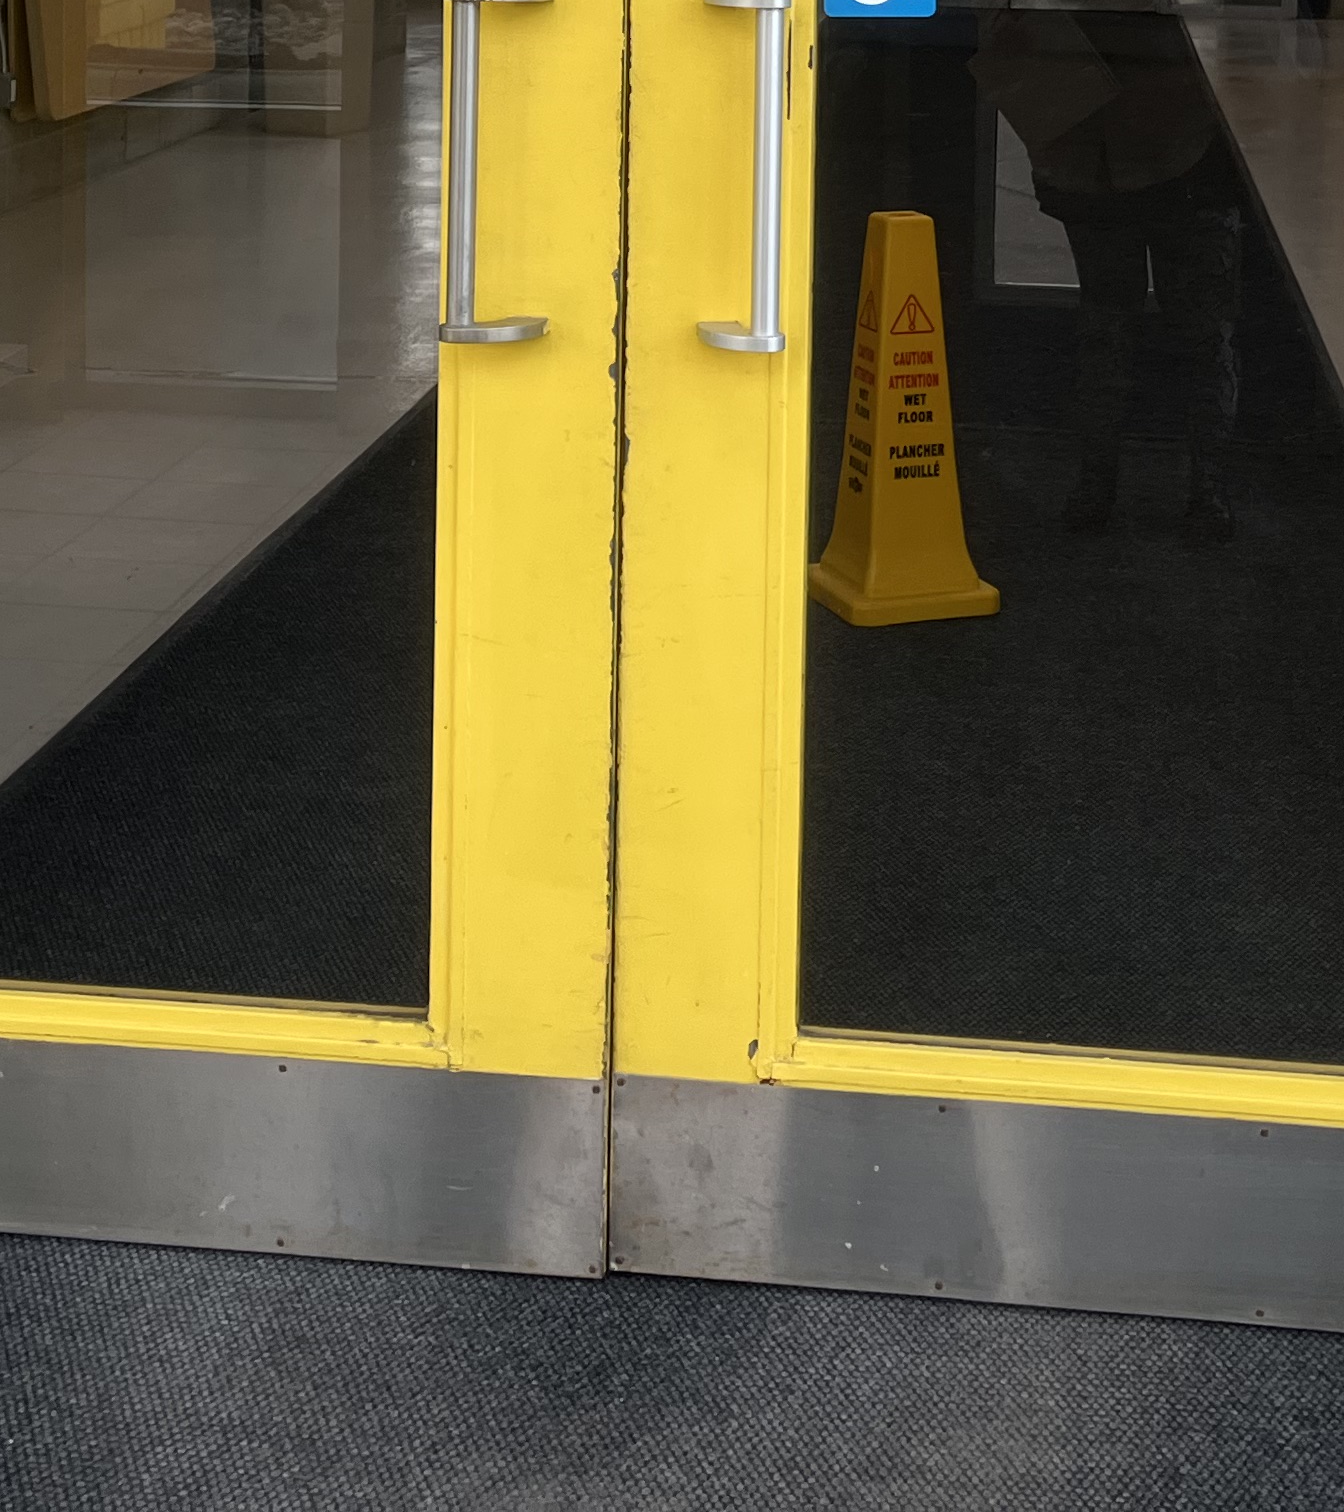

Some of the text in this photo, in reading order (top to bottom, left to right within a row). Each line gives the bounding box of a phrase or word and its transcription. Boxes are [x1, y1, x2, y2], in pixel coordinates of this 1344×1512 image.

[893, 351, 933, 366] CAUTION
[889, 374, 939, 389] ATTENTION
[903, 393, 927, 407] WET
[897, 410, 933, 425] FLOOR
[889, 443, 945, 460] PLANCHER
[894, 460, 940, 480] MOUILLÉ
